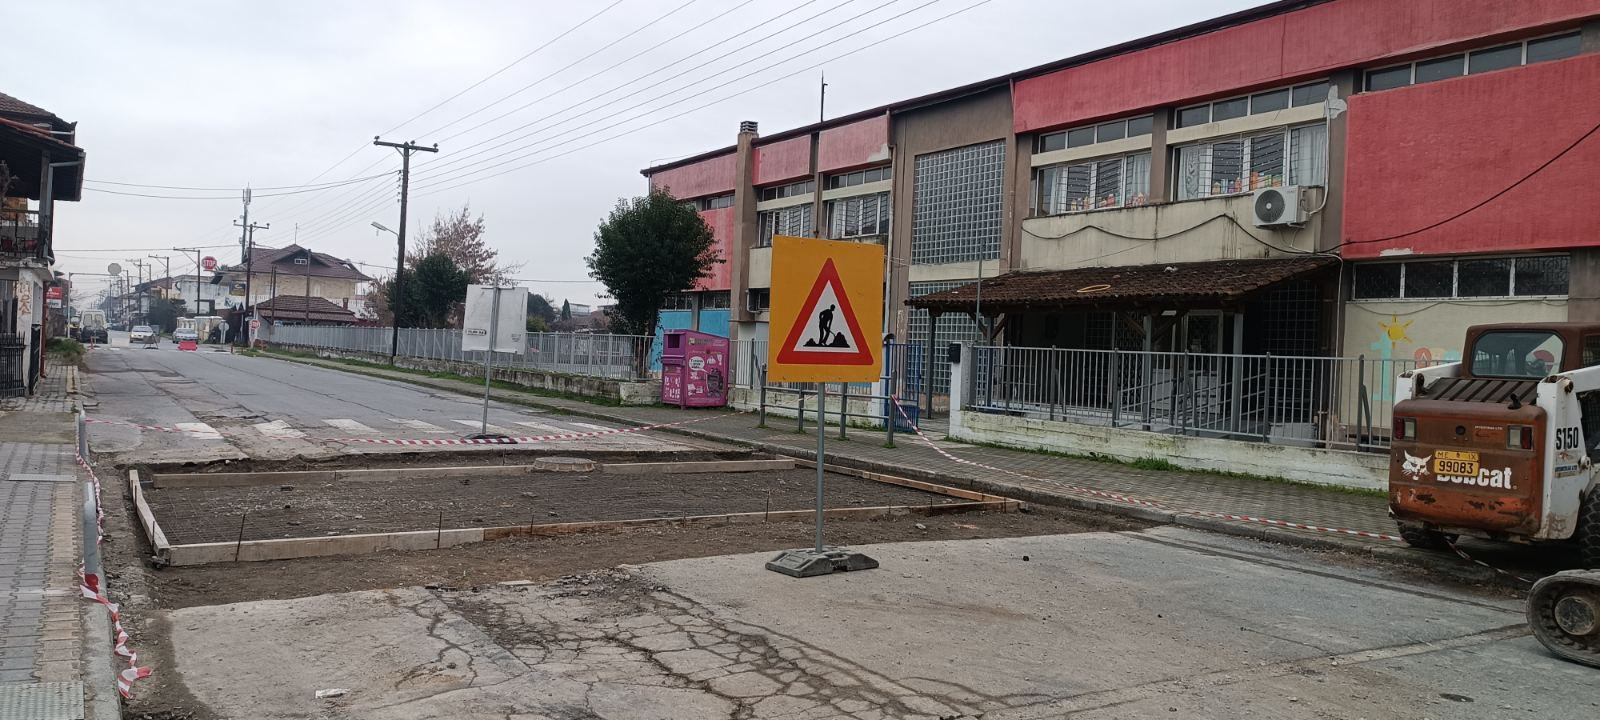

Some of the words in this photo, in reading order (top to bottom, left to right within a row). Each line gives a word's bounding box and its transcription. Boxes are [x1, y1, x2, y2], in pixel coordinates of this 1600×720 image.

[202, 259, 216, 267] STOP
[1556, 427, 1579, 450] S150
[1439, 460, 1473, 474] 99083
